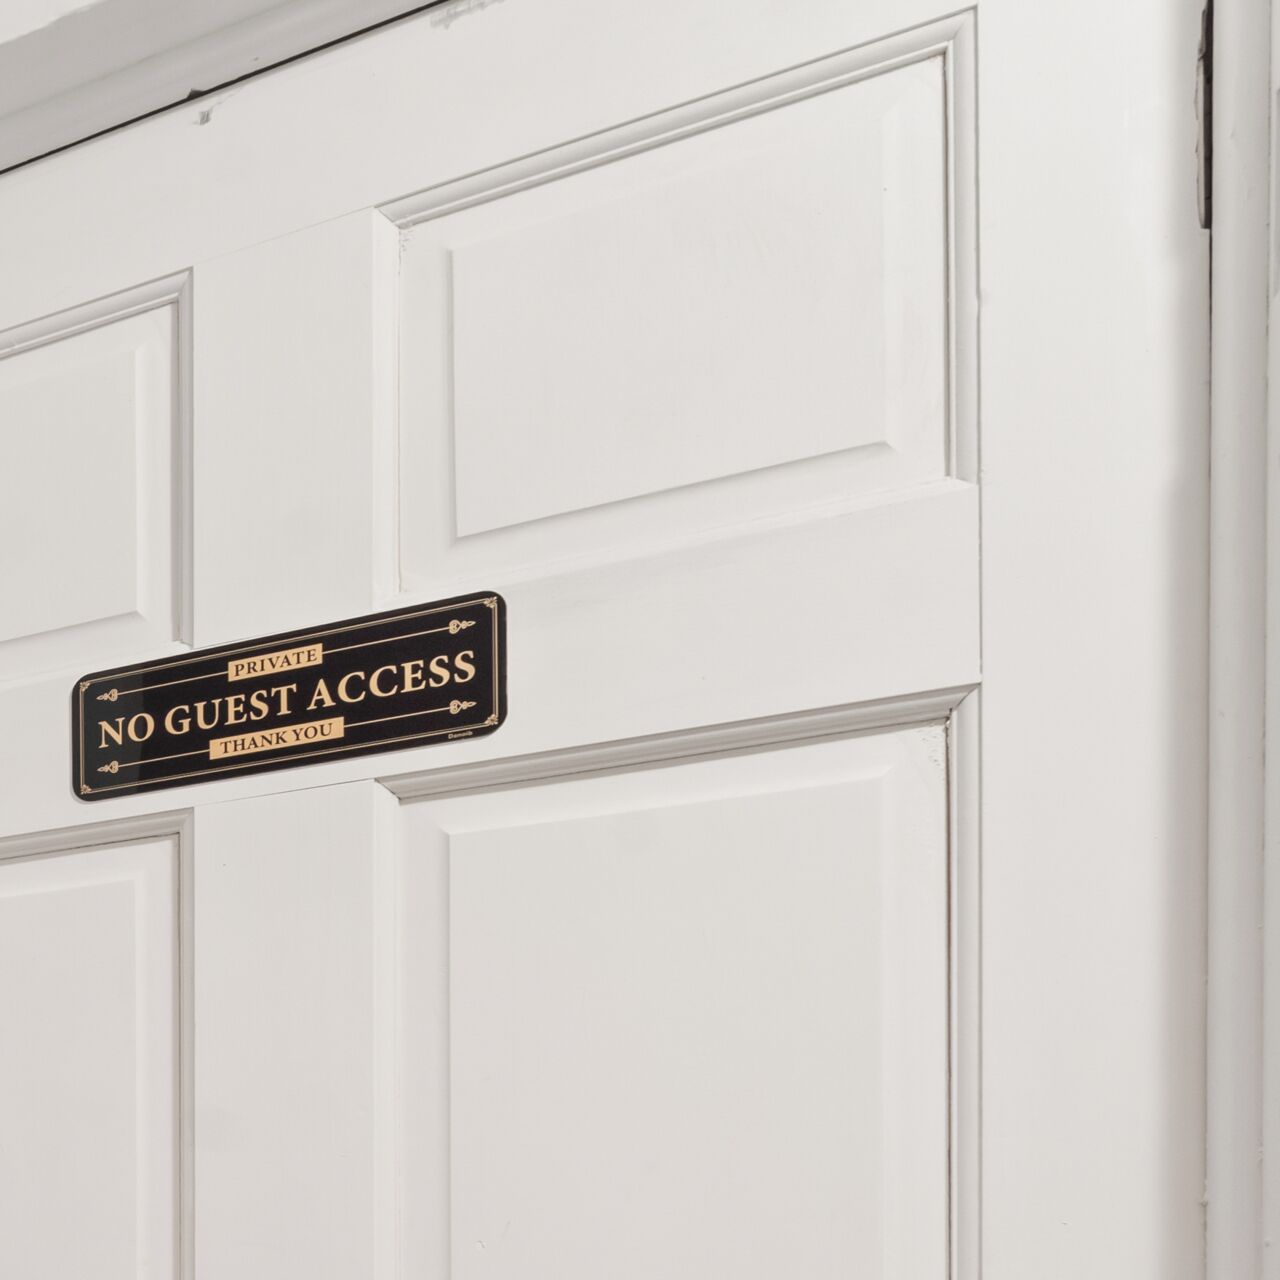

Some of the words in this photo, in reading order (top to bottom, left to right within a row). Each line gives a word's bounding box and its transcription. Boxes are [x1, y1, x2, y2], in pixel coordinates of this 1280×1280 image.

[234, 648, 318, 677] PRIVATE
[98, 712, 155, 749] NO
[164, 683, 297, 735] GUEST
[306, 650, 476, 711] ACCESS
[219, 730, 288, 755] THANK
[292, 722, 334, 742] YOU
